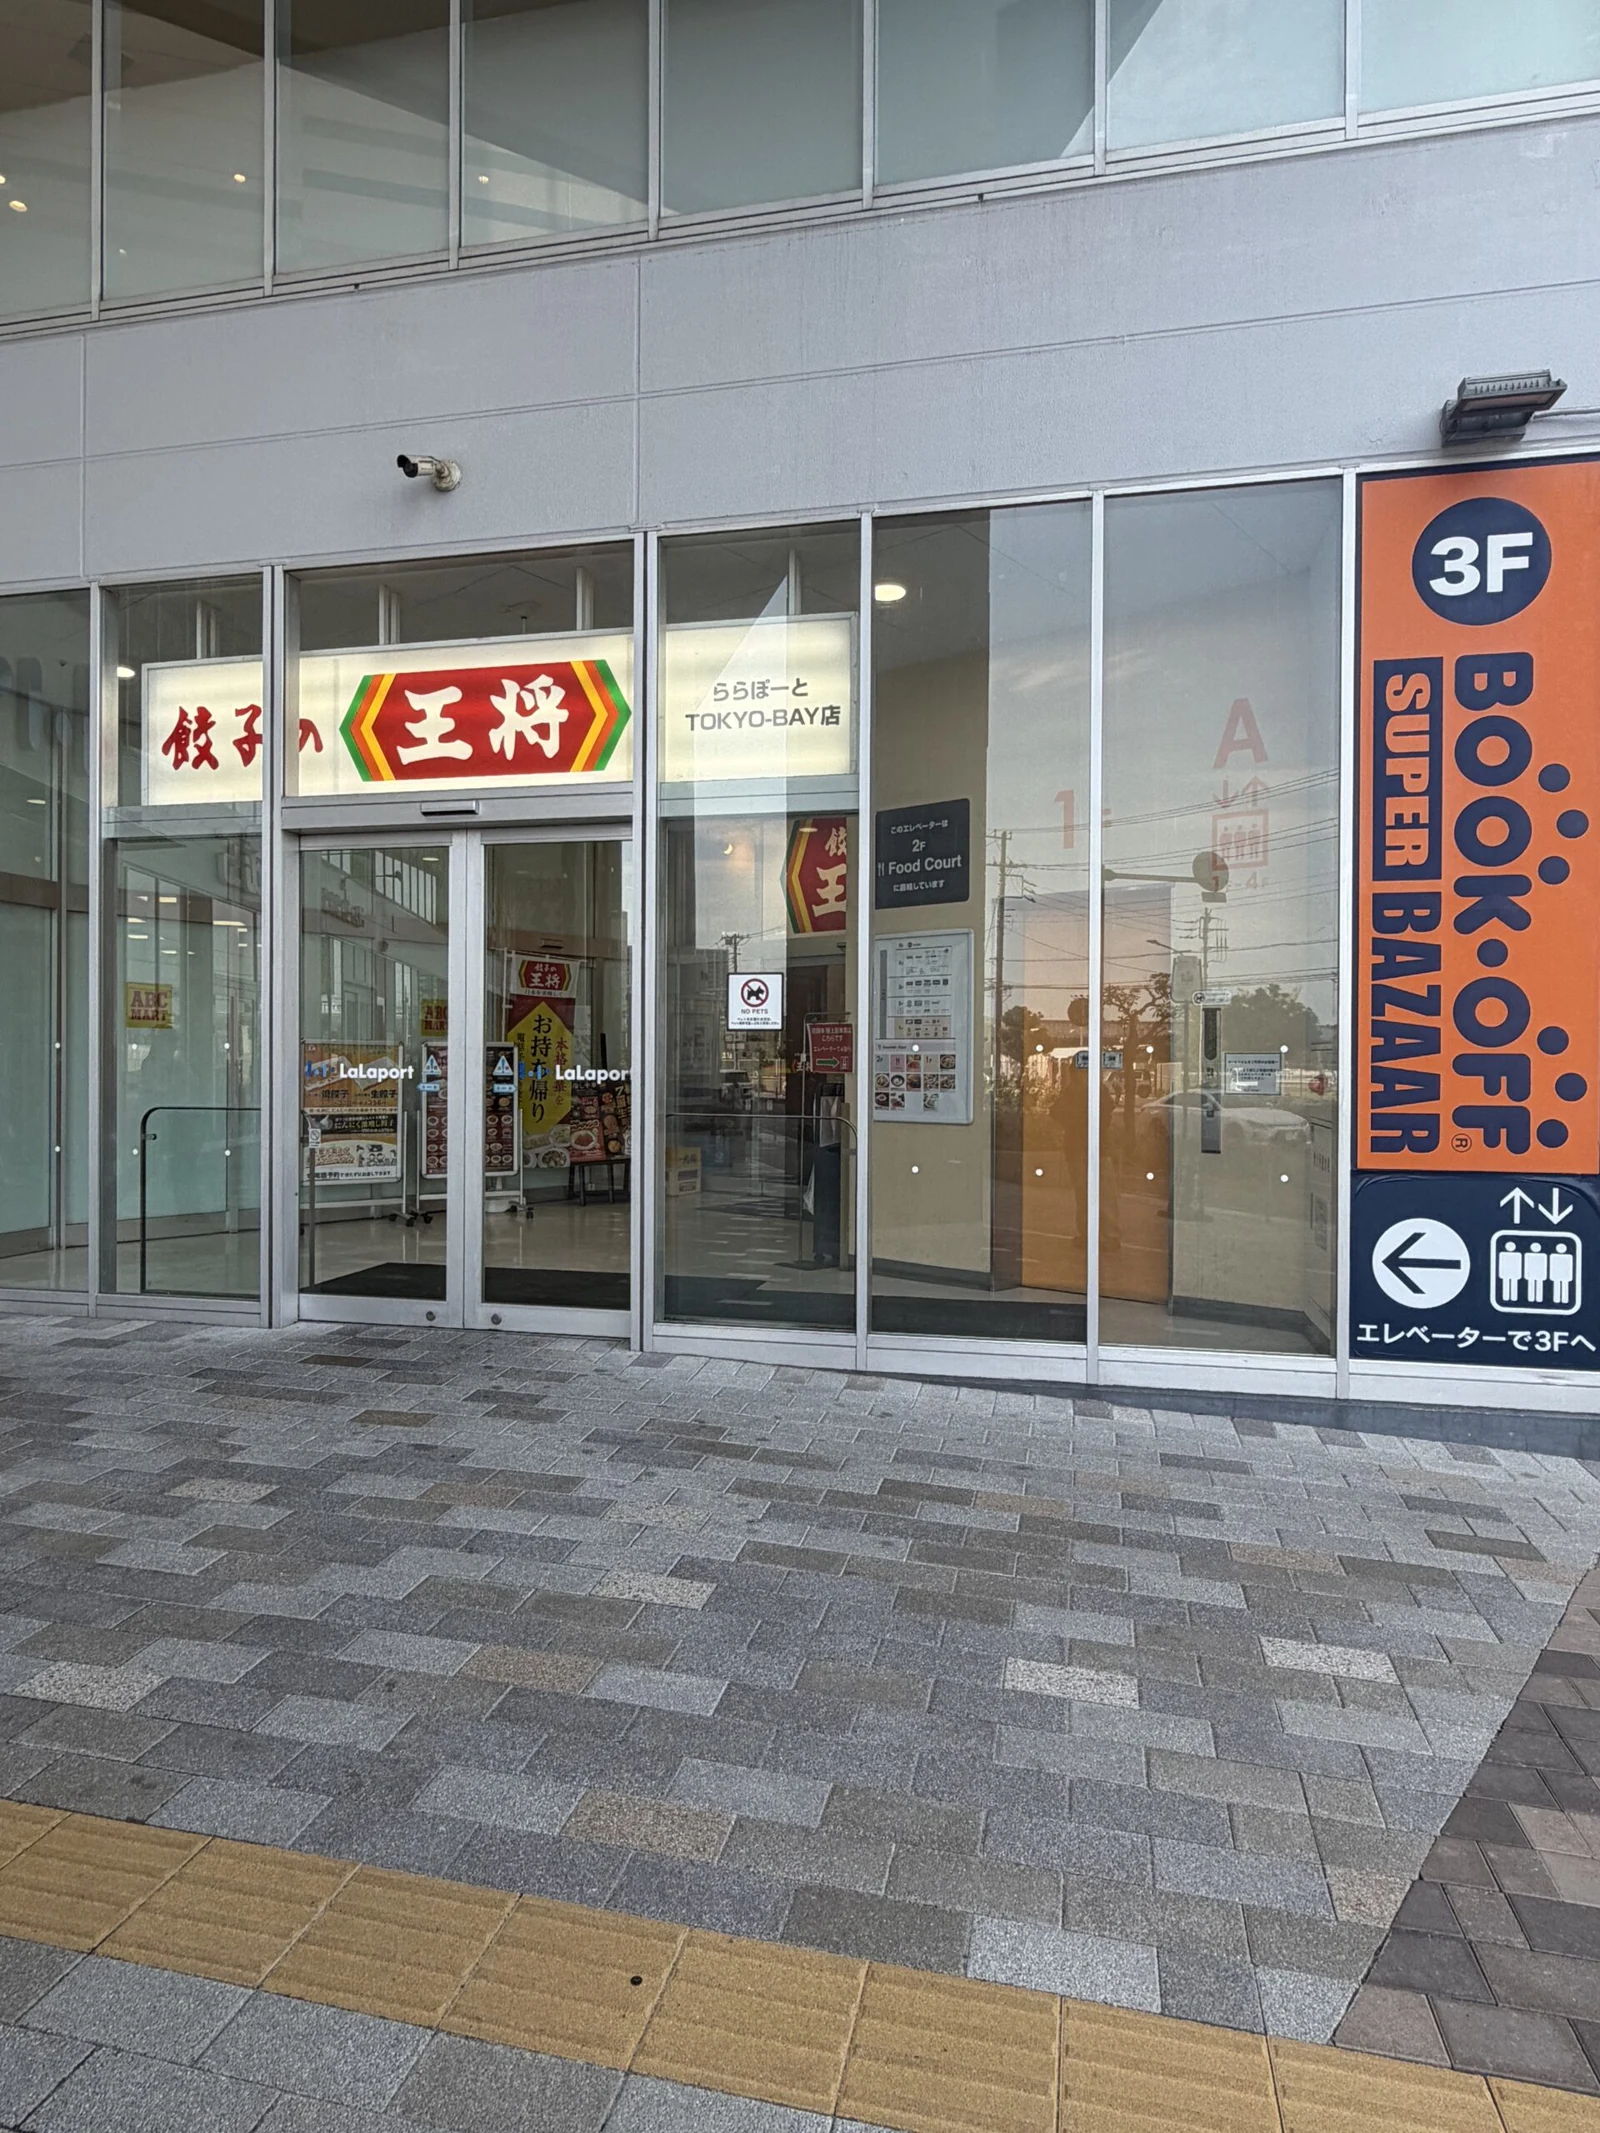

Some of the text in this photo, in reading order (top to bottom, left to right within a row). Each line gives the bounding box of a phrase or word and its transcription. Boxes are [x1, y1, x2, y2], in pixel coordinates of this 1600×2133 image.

[1428, 531, 1534, 597] 3F
[713, 677, 809, 702] ららぽーと
[396, 673, 570, 766] 王将
[685, 704, 841, 732] TOKYO-BAY店
[1212, 698, 1269, 769] A
[890, 819, 949, 835] このエレベーターは
[911, 838, 926, 853] 2F
[888, 854, 962, 875] Food Court
[1370, 672, 1442, 1154] SUPER BAZAAR
[529, 972, 561, 990] 王将
[339, 1063, 415, 1083] LaLaport
[555, 1064, 633, 1085] LaLapor
[1356, 1323, 1597, 1352] エレベーターで3Fへ
